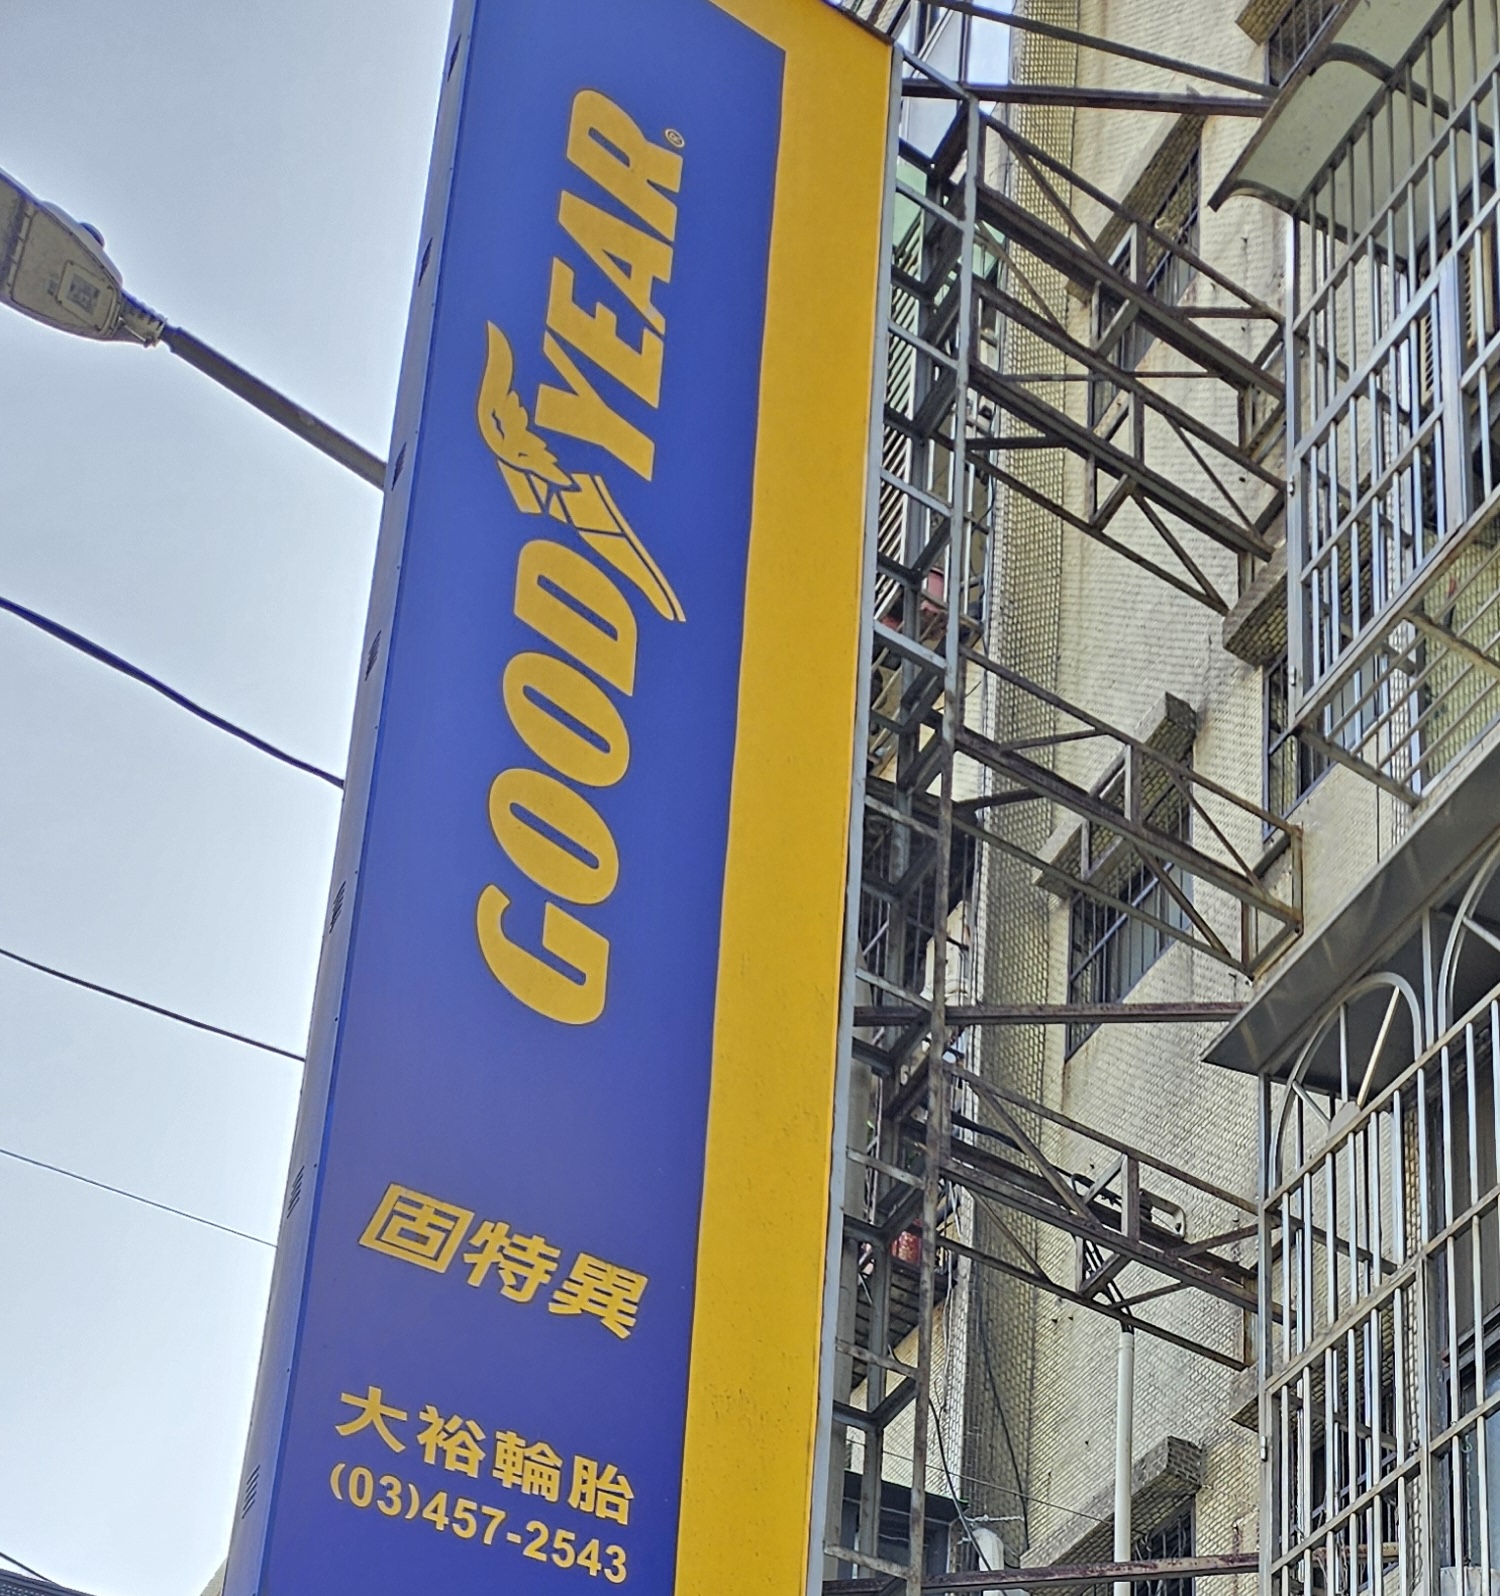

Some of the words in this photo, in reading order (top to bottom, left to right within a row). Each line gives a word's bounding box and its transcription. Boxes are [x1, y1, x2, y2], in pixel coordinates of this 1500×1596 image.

[476, 89, 683, 1024] GOODYEAR
[359, 1183, 649, 1339] 固特異
[329, 1462, 628, 1584] (03)457-2543
[335, 1385, 635, 1526] 大裕輪胎
